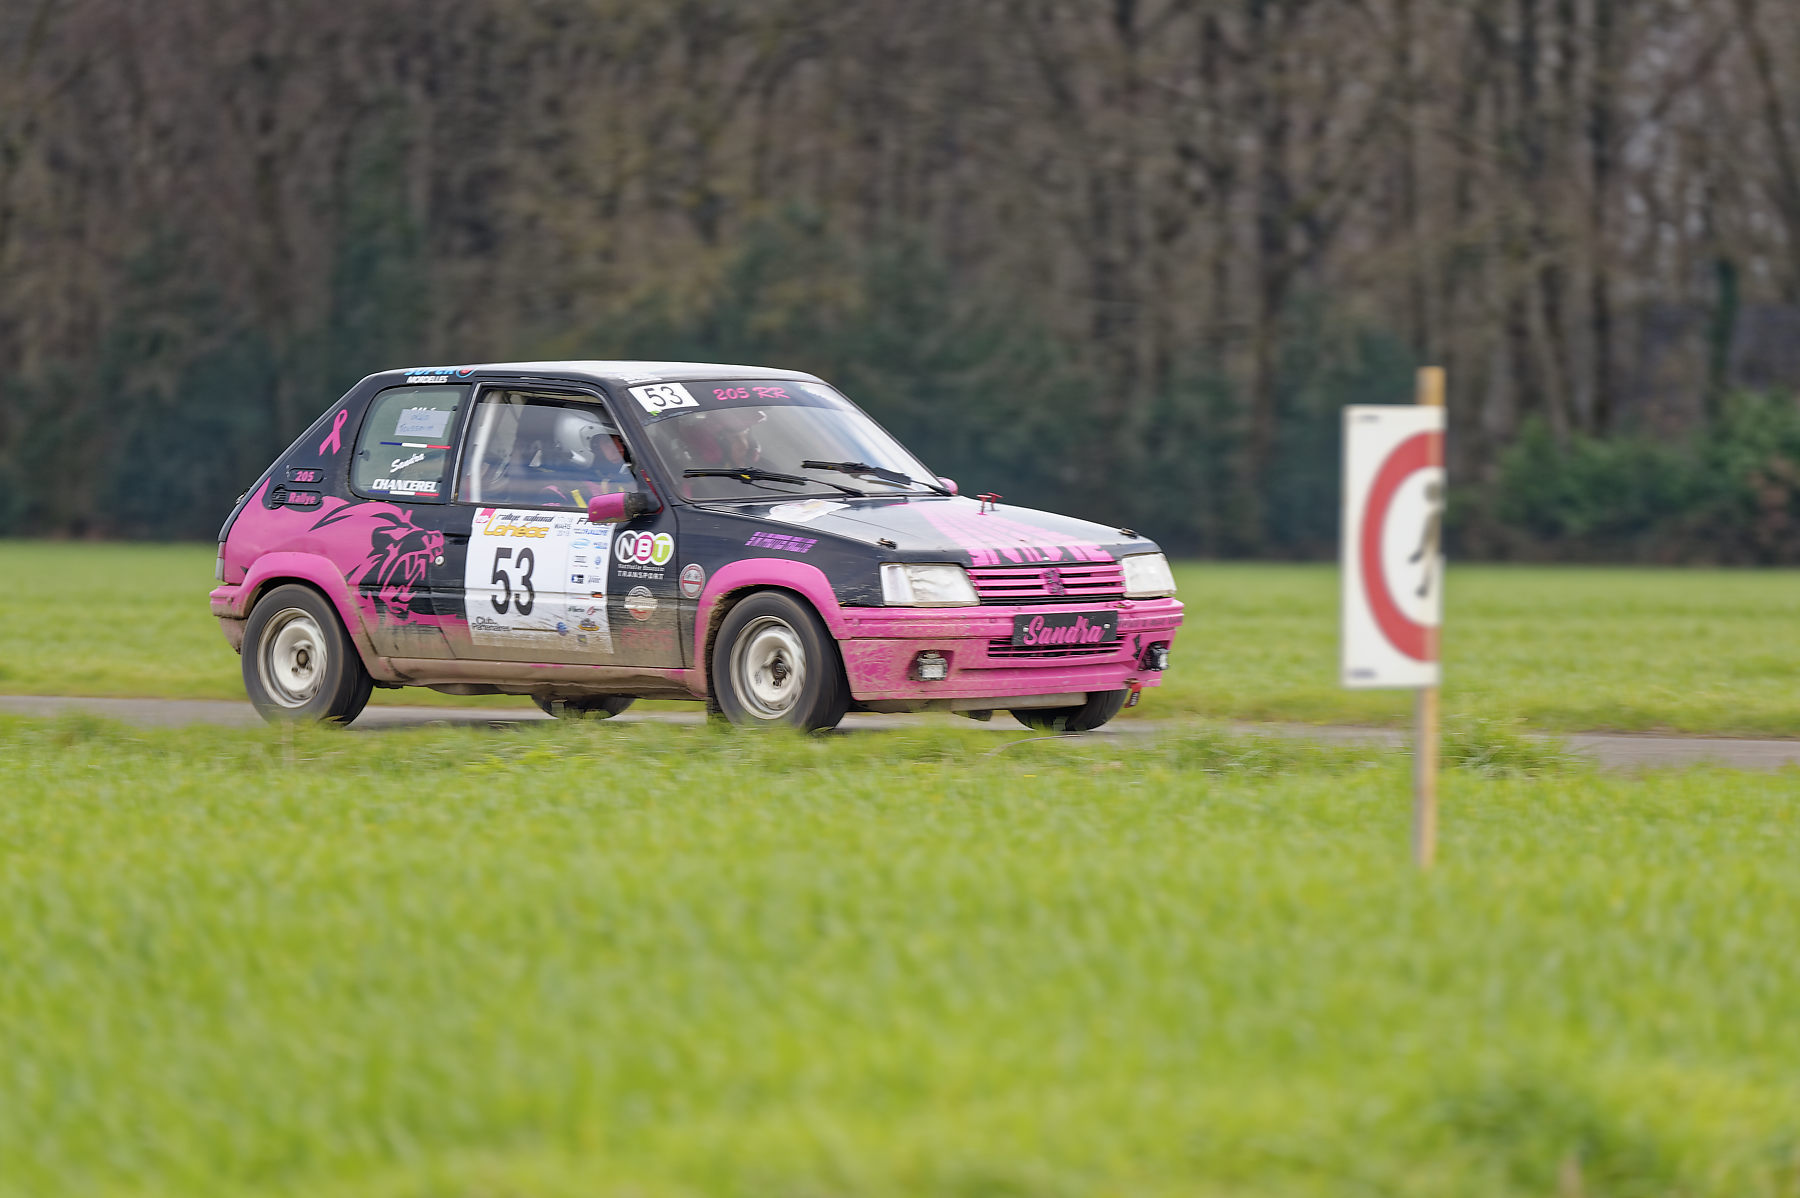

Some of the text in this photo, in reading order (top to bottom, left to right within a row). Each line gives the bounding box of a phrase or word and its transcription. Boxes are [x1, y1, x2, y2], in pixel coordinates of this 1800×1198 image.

[406, 375, 449, 384] MORDELLES
[643, 386, 683, 407] 53
[713, 386, 790, 401] 205 RR
[295, 470, 315, 482] 205
[371, 478, 438, 492] CHANCEREL
[287, 491, 317, 506] Rallye
[618, 536, 672, 560] NBT
[490, 547, 535, 616] 53
[617, 570, 665, 580] TRANSPORT
[1023, 615, 1106, 646] Sandra
